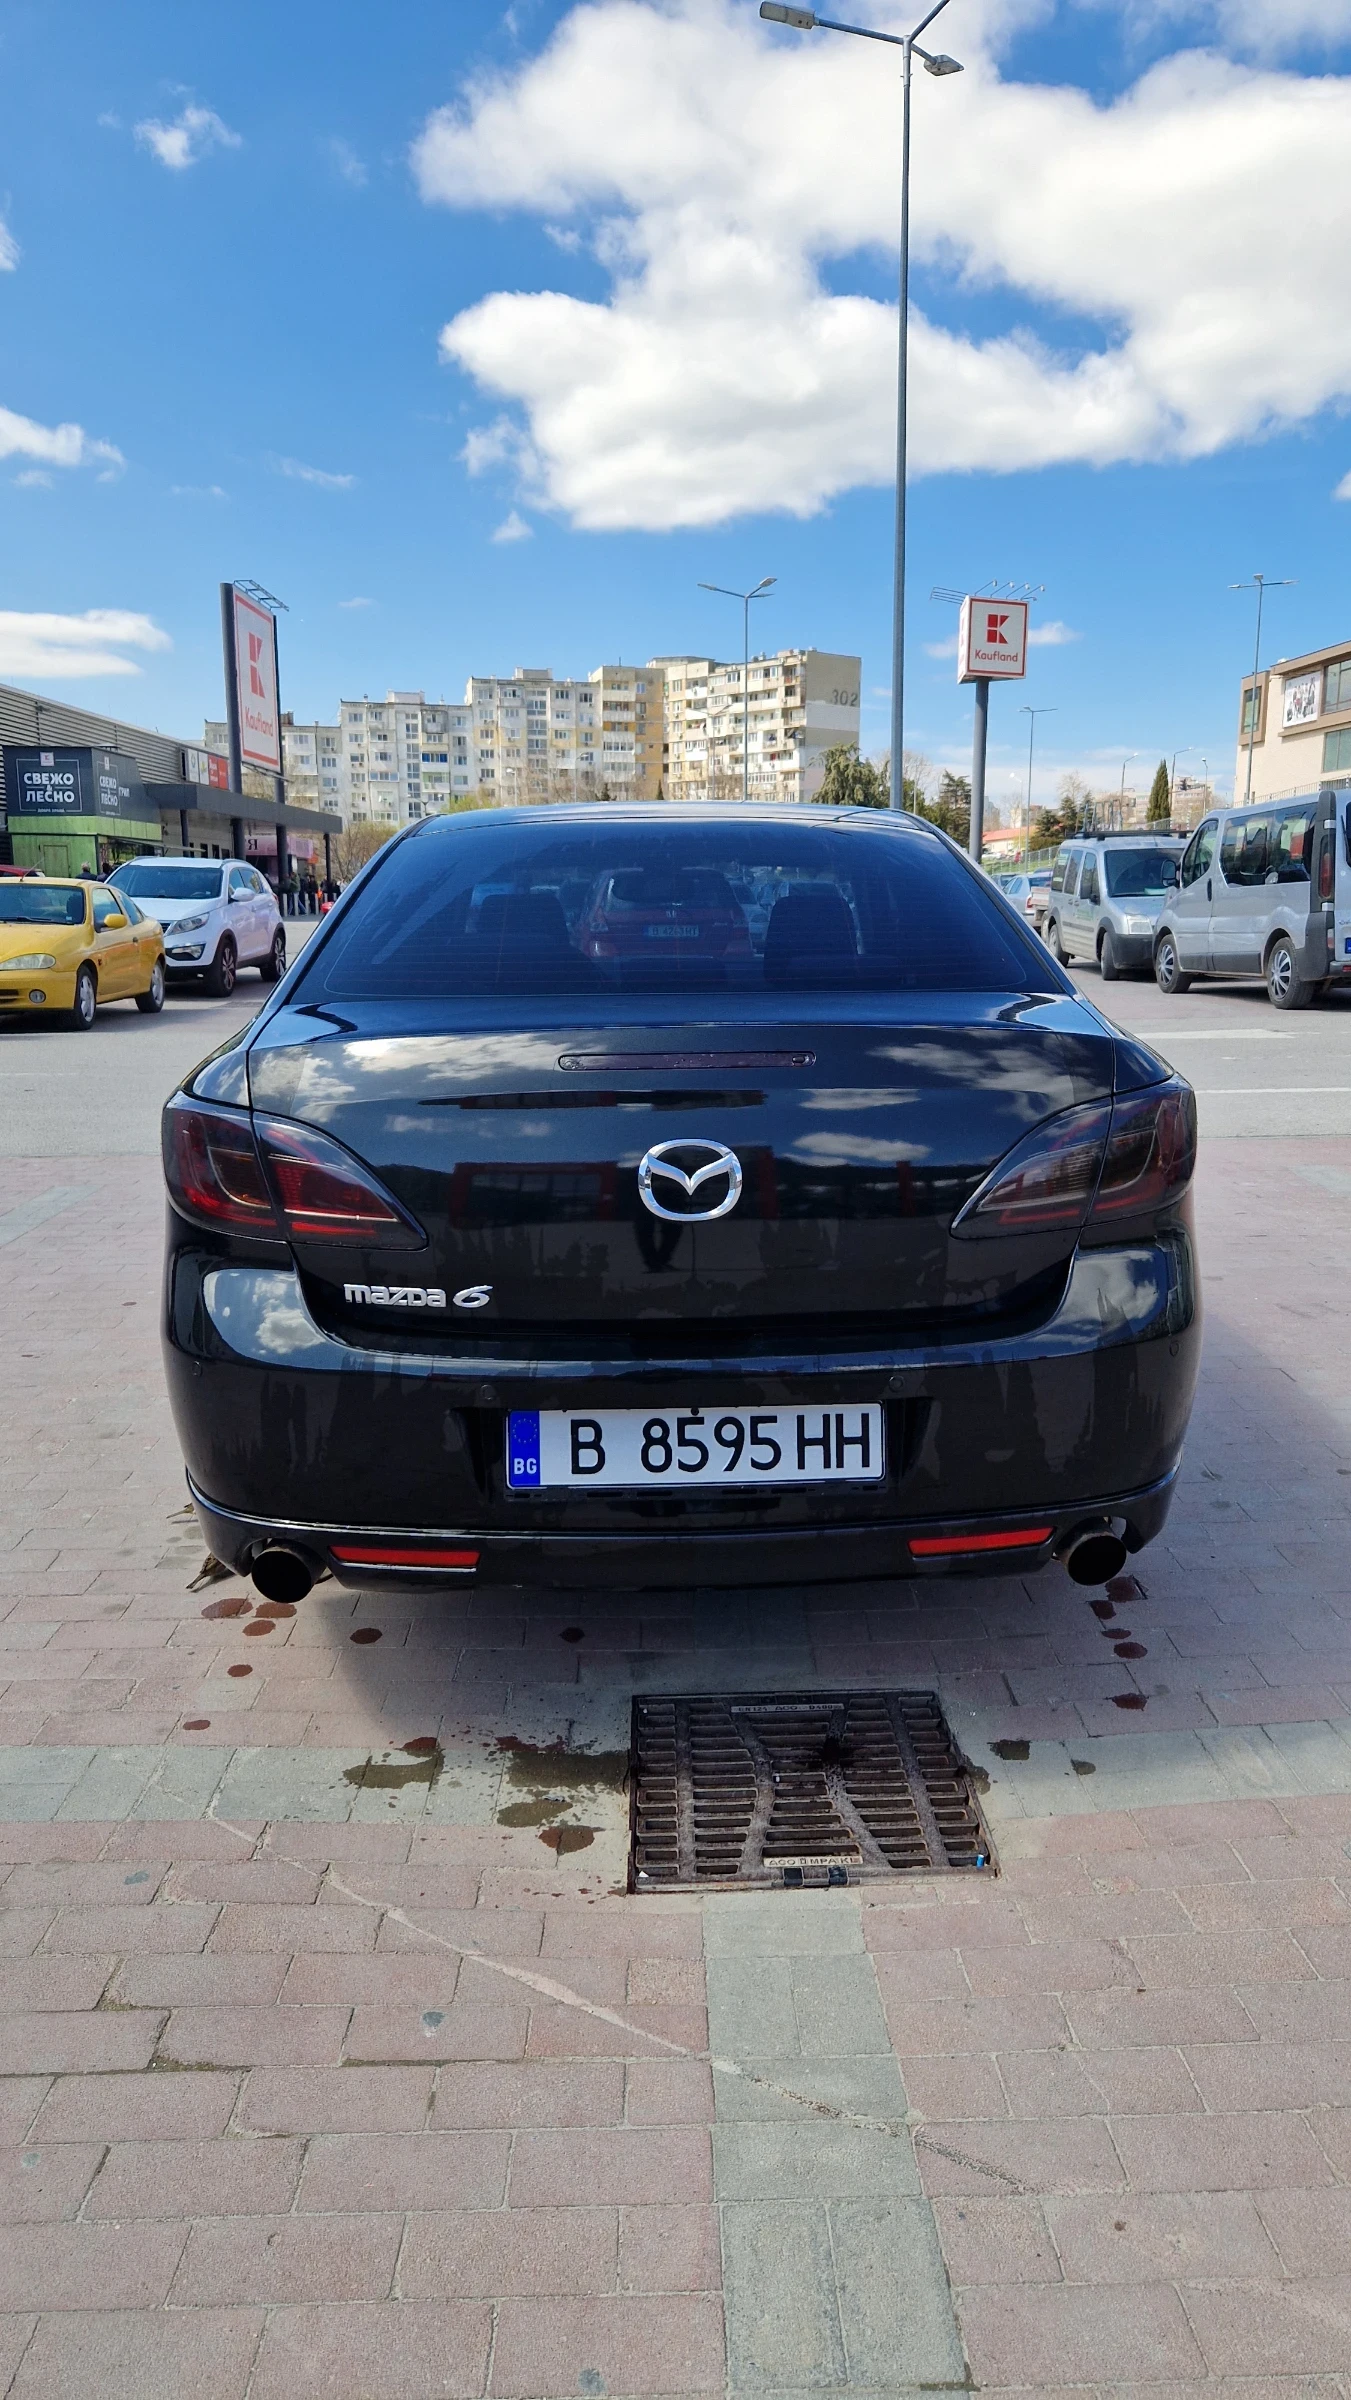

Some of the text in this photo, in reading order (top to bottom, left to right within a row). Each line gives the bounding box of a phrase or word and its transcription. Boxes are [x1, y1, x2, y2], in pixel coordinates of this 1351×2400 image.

[974, 649, 1019, 662] Kaufland
[831, 689, 859, 707] 302
[244, 706, 275, 737] Kaufland
[23, 773, 75, 786] СВЕЖО
[99, 775, 117, 790] СВЕЖО
[25, 790, 75, 803] ЛЕСНО
[452, 1284, 493, 1308] 6
[569, 1418, 606, 1475] B
[513, 1456, 537, 1475] BG
[769, 1858, 796, 1866] ACO
